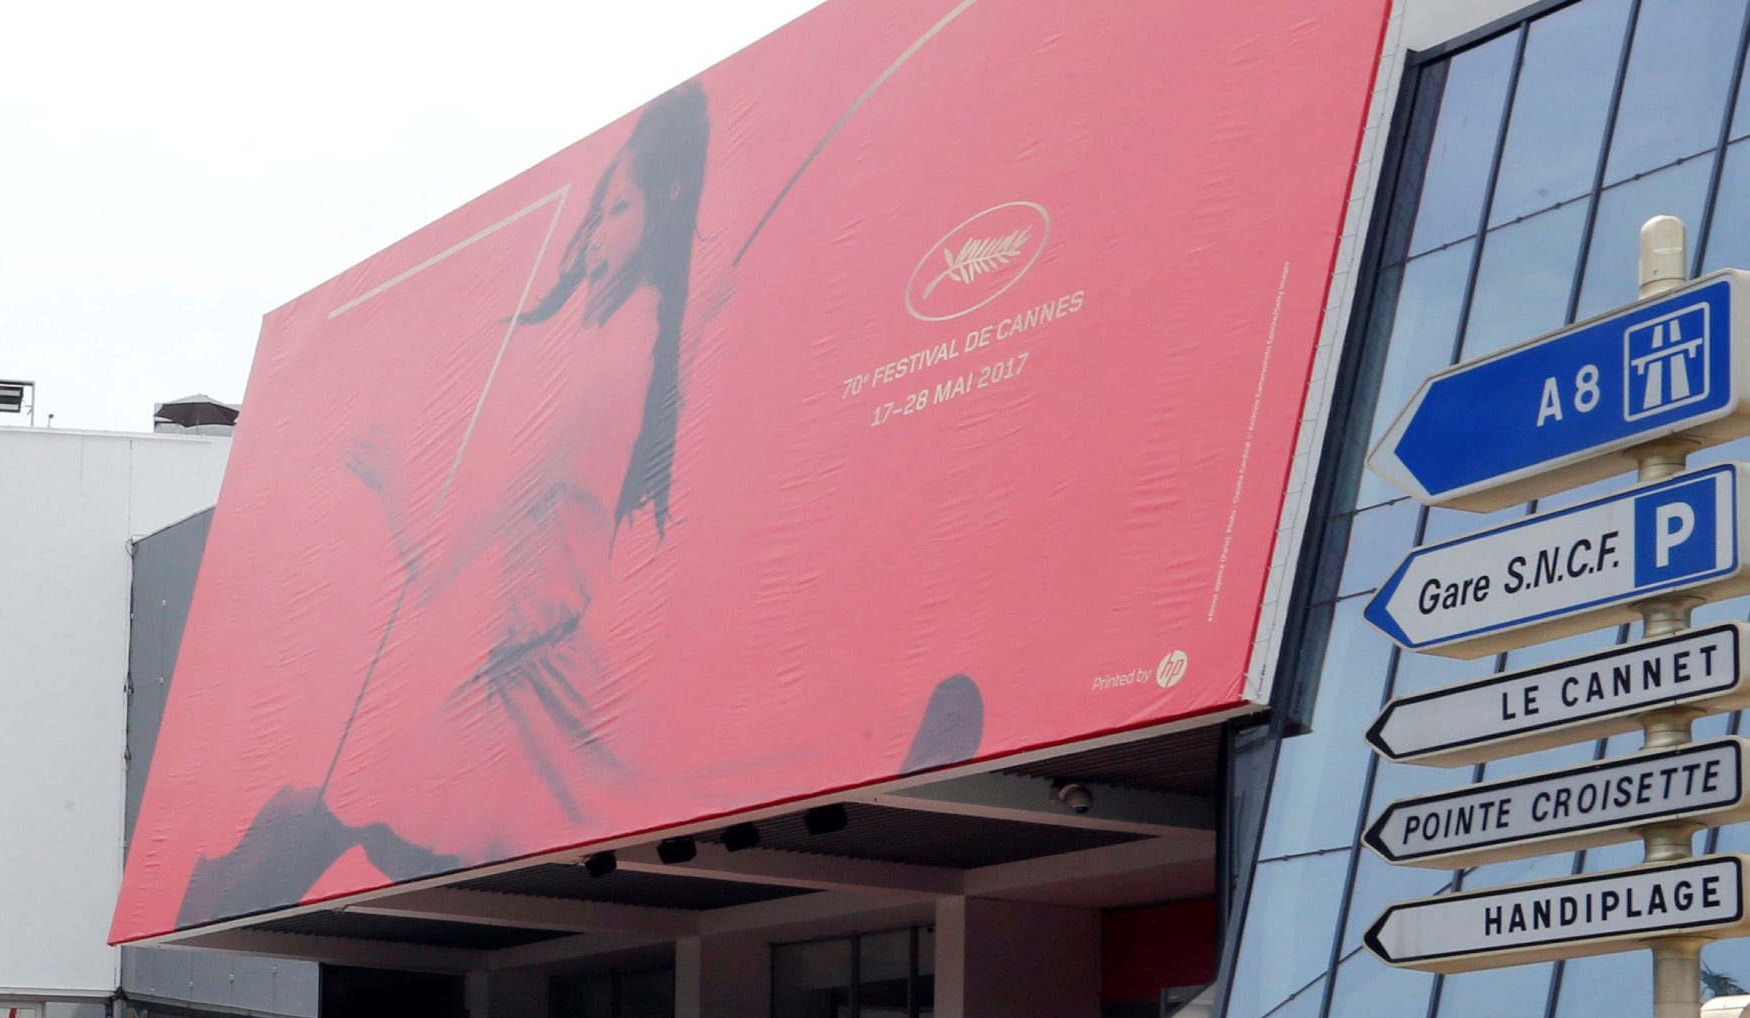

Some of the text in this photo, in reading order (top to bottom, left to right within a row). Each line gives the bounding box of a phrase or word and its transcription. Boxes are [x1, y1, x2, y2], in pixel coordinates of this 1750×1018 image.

[872, 339, 959, 388] FESTIVAL
[964, 324, 993, 352] DE
[996, 290, 1085, 340] CANNES
[870, 352, 1030, 427] 17-28 MAI 2017
[1418, 501, 1695, 615] Gare S.N.C.F. P
[1092, 669, 1135, 691] Printed
[1136, 668, 1152, 684] by
[1502, 645, 1717, 721] LE CANNET
[1402, 759, 1720, 845] POINTE CROISETTE
[1485, 875, 1720, 936] HANDIPLAGE
